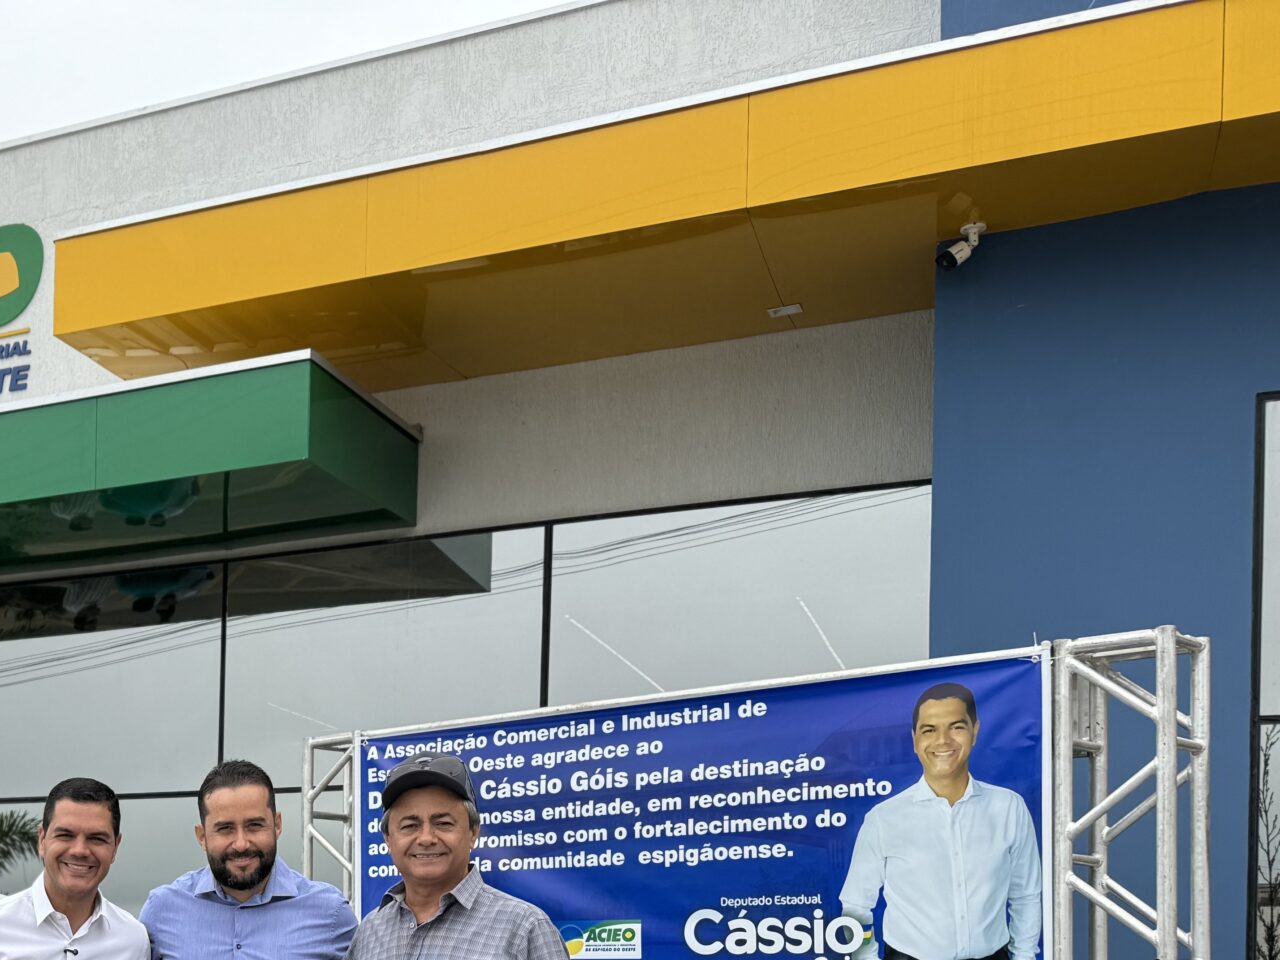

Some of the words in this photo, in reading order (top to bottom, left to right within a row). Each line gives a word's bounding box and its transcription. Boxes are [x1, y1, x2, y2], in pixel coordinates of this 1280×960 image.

[367, 746, 379, 760] A
[384, 733, 488, 760] Associação
[493, 719, 595, 746] Comercial
[602, 720, 615, 734] e
[622, 702, 731, 731] Industrial
[738, 700, 768, 718] de
[469, 755, 525, 773] Oeste
[531, 744, 630, 769] agradece
[636, 740, 663, 756] ao
[480, 774, 562, 800] Cássio
[570, 768, 629, 792] Góis
[635, 767, 683, 790] pela
[690, 753, 826, 782] destinação
[479, 808, 536, 825] nossa
[542, 798, 641, 820] entidade,
[647, 795, 682, 812] em
[689, 778, 893, 809] reconhecimento
[563, 828, 608, 843] com
[614, 826, 627, 840] o
[634, 812, 807, 839] fortalecimento
[815, 809, 847, 828] do
[498, 850, 625, 871] comunidade
[638, 842, 794, 867] espigãoense.
[720, 895, 772, 908] Deputado
[774, 894, 822, 905] Estadual
[585, 927, 636, 942] ACIEO
[683, 908, 864, 956] Cássio
